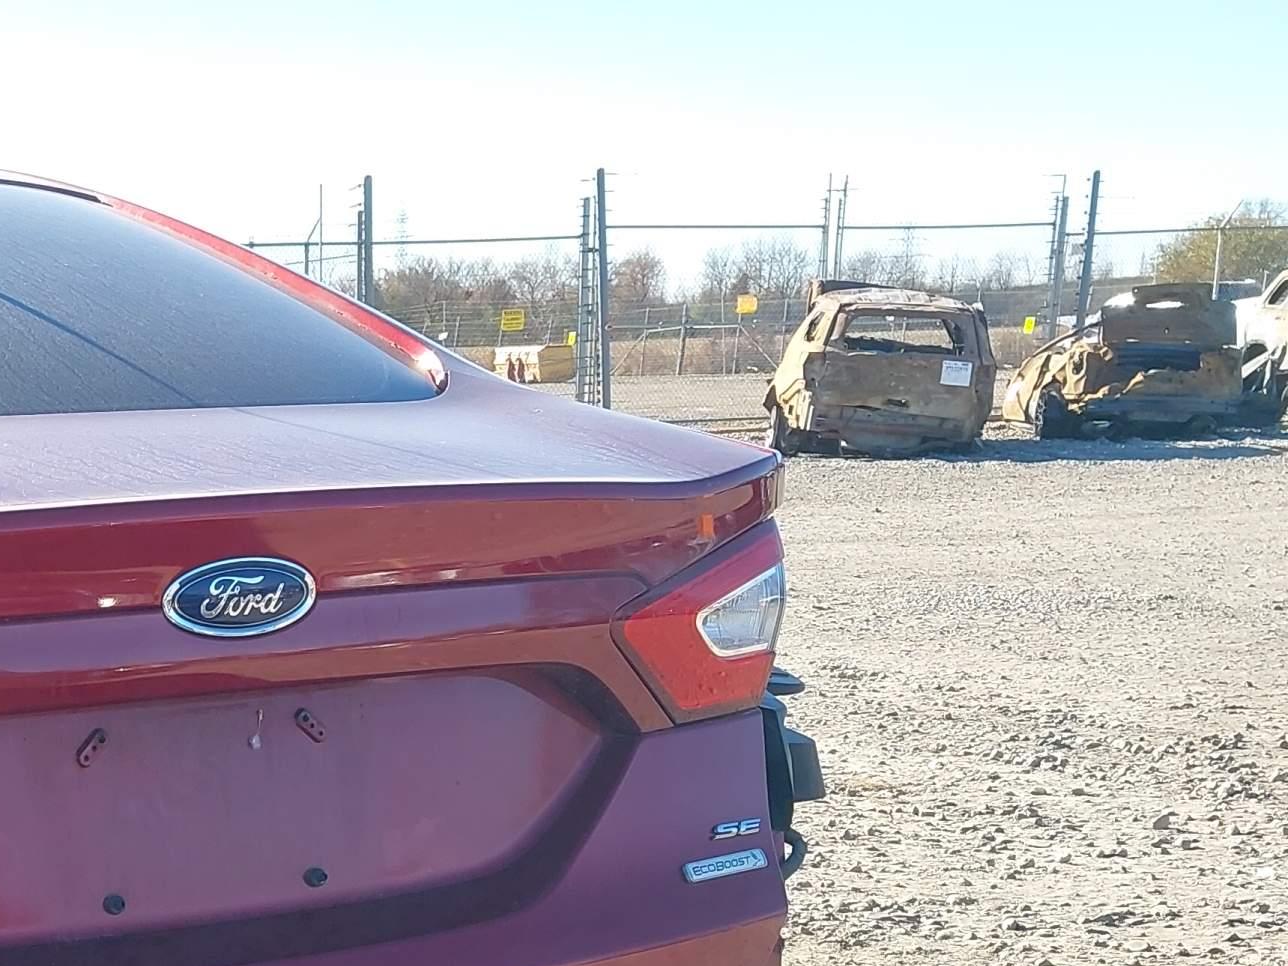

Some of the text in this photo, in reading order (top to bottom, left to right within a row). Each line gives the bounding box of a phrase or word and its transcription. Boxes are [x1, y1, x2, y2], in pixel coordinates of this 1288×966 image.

[200, 575, 285, 619] Ford
[710, 818, 761, 841] SE
[692, 855, 752, 877] ECOBOOST
